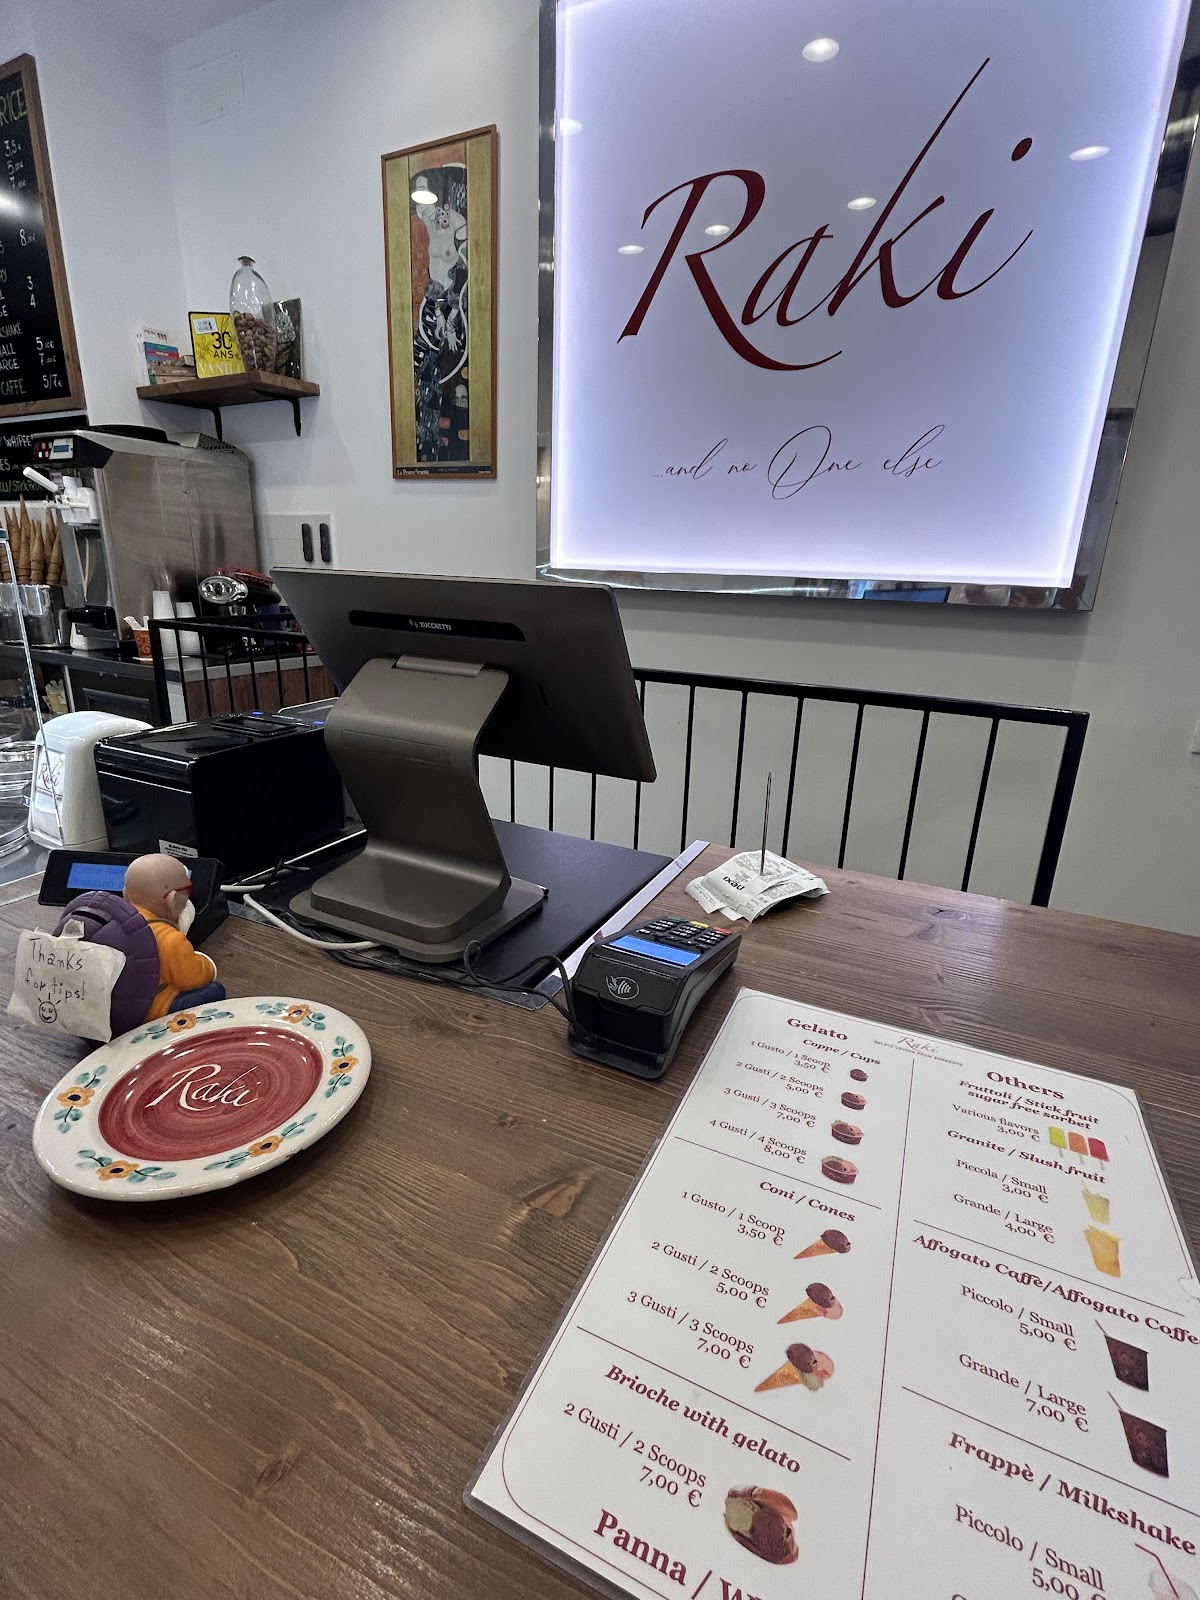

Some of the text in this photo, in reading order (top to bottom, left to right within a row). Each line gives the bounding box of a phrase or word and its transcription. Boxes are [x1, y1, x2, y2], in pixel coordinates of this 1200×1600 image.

[617, 57, 1033, 371] Raki
[214, 350, 234, 359] ANS
[727, 459, 757, 476] no
[767, 425, 862, 500] One
[883, 424, 946, 477] else
[419, 621, 452, 631] ZUCCHETTI
[29, 938, 83, 972] Thanks
[25, 967, 86, 1004] for tips!
[787, 1018, 848, 1040] Gelato
[898, 1037, 939, 1053] Raki
[758, 1041, 785, 1056] Gusto
[800, 1053, 831, 1068] Scoop
[794, 1059, 829, 1074] 3,50 €
[803, 1039, 840, 1056] Coppe
[850, 1052, 881, 1066] Cups
[144, 1064, 262, 1112] Raki
[744, 1062, 769, 1076] Gusti
[788, 1075, 824, 1092] Scoops
[786, 1084, 809, 1095] 5,00
[987, 1072, 1064, 1100] Others
[733, 1088, 760, 1102] Gusti
[780, 1103, 816, 1120] Scoops
[777, 1111, 815, 1128] 7,00 €
[952, 1104, 1039, 1135] Various flavors
[959, 1080, 1012, 1100] Fruttoli
[1026, 1098, 1062, 1114] Stick
[1063, 1108, 1100, 1125] fruit
[968, 1091, 1092, 1130] sugar free sorbet
[720, 1120, 747, 1136] Gusti
[768, 1136, 807, 1155] Scoops
[998, 1125, 1041, 1142] 3,00 €
[764, 1145, 805, 1164] 8,00 €
[948, 1131, 1005, 1154] Granite
[1020, 1151, 1064, 1171] Slush
[1064, 1166, 1106, 1184] fruit
[956, 1159, 998, 1180] Piccola
[1011, 1176, 1047, 1194] Small
[1002, 1183, 1049, 1204] 3,00 €
[692, 1193, 726, 1213] Gusto
[738, 1212, 744, 1220] 1
[748, 1214, 785, 1237] Scoop
[760, 1181, 795, 1200] Coni
[808, 1199, 855, 1222] Cones
[954, 1194, 1001, 1216] Grande
[1014, 1213, 1053, 1234] Large
[737, 1223, 783, 1246] 3,50 €
[1005, 1222, 1055, 1244] 4,00 €
[652, 1241, 661, 1250] 2
[664, 1242, 697, 1266] Gusti
[710, 1265, 719, 1274] 2
[722, 1268, 769, 1296] Scoops
[716, 1282, 767, 1308] 5,00 €
[913, 1235, 990, 1268] Affogato
[1145, 1317, 1200, 1345] Coffe
[628, 1291, 637, 1303] 3
[641, 1294, 678, 1319] Gusti
[689, 1319, 700, 1332] 3
[702, 1323, 754, 1354] Scoops
[961, 1285, 1013, 1314] Piccolo
[1030, 1311, 1074, 1336] Small
[697, 1338, 751, 1369] 7,00 €
[1020, 1323, 1077, 1351] 5,00 €
[960, 1353, 1020, 1388] Grande
[1037, 1384, 1087, 1416] Large
[605, 1365, 801, 1473] Brioche with gelato
[1026, 1398, 1089, 1434] 7,00 €
[564, 1403, 575, 1416] 2
[578, 1407, 620, 1440] Gusti
[634, 1440, 645, 1454] 2
[648, 1445, 706, 1488] Scoops
[639, 1466, 702, 1507] 7,00 €
[948, 1432, 1034, 1482] Frappè
[1056, 1479, 1197, 1556] Milkshake
[593, 1509, 687, 1586] Panna
[955, 1504, 1024, 1551] Piccolo
[1045, 1548, 1105, 1592] Small
[1032, 1567, 1080, 1600] 5,00
